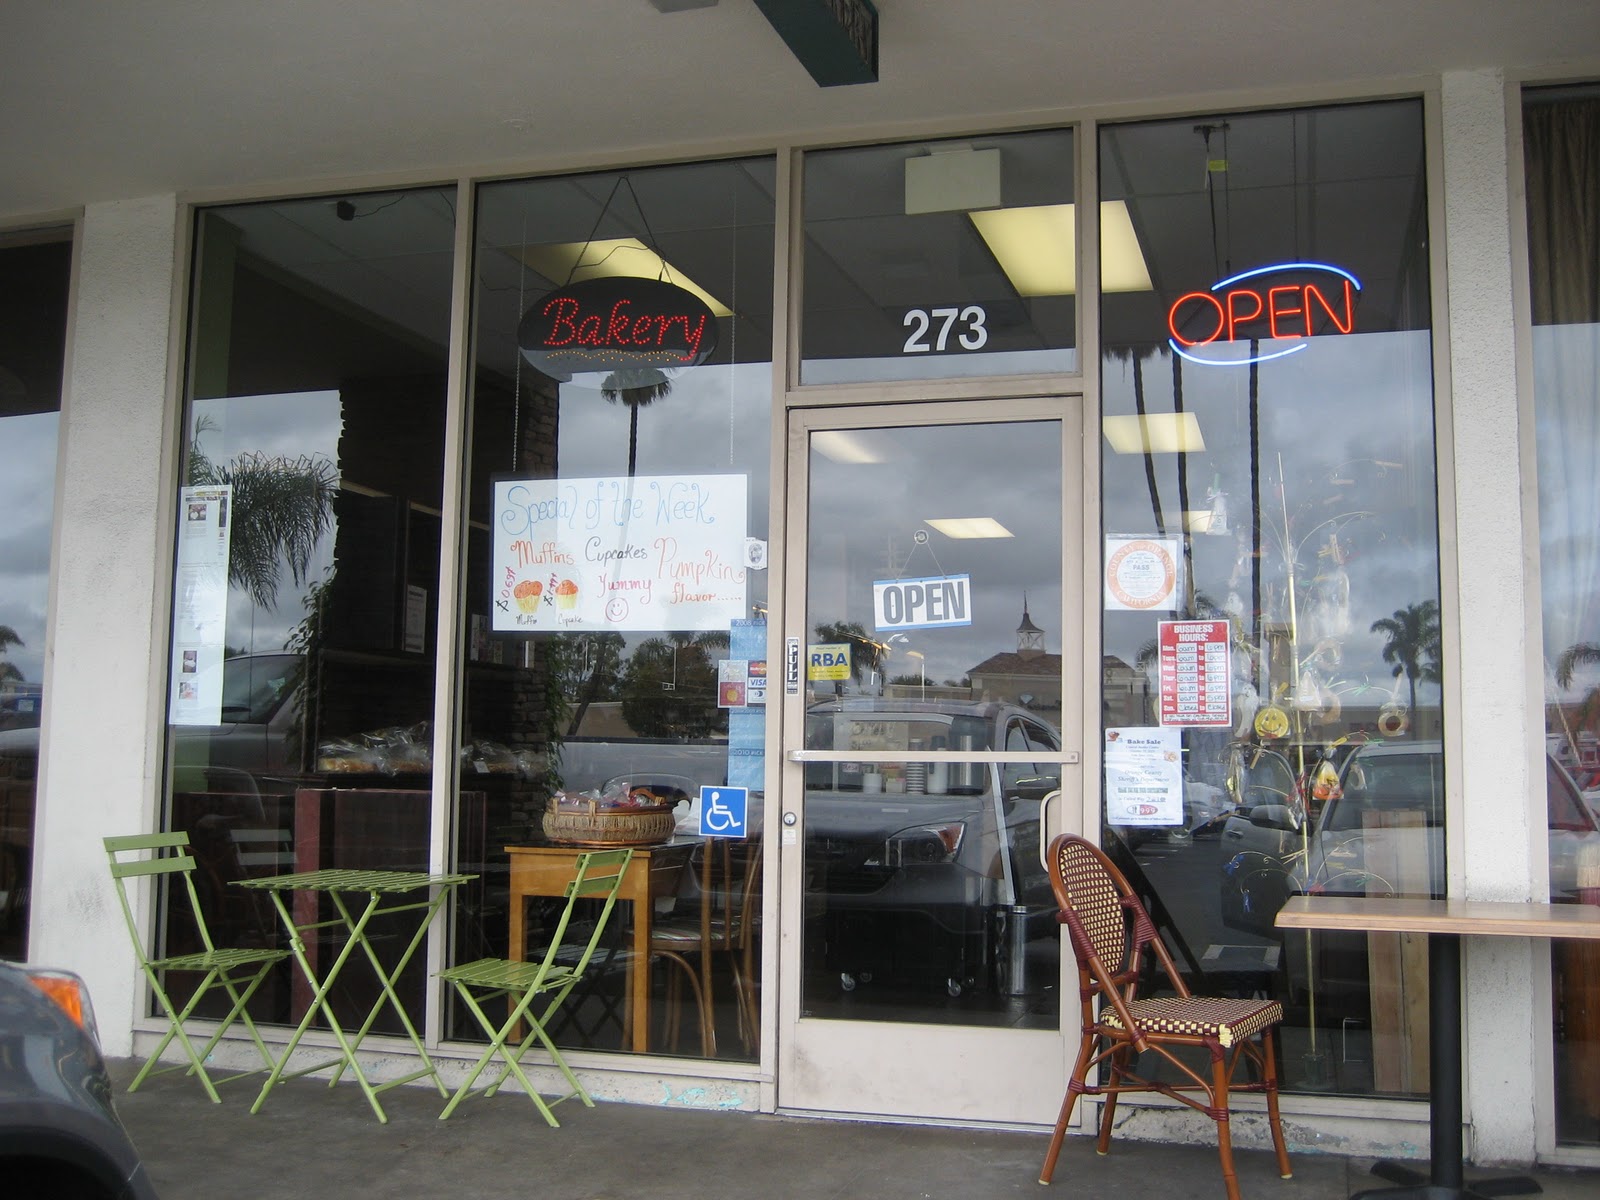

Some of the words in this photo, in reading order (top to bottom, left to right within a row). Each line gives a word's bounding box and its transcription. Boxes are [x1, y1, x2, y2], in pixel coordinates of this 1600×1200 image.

[543, 297, 706, 362] Bakery
[902, 306, 988, 353] 273
[1168, 281, 1354, 347] OPEN
[501, 486, 577, 540] Special
[586, 481, 604, 529] of
[610, 481, 643, 526] the
[510, 540, 575, 568] Muffins
[597, 573, 652, 605] Yummy
[883, 581, 966, 625] OPEN
[1174, 624, 1214, 633] BUSINESS
[1179, 633, 1209, 642] HOURS:
[788, 645, 798, 681] PULL
[811, 652, 848, 667] RBA
